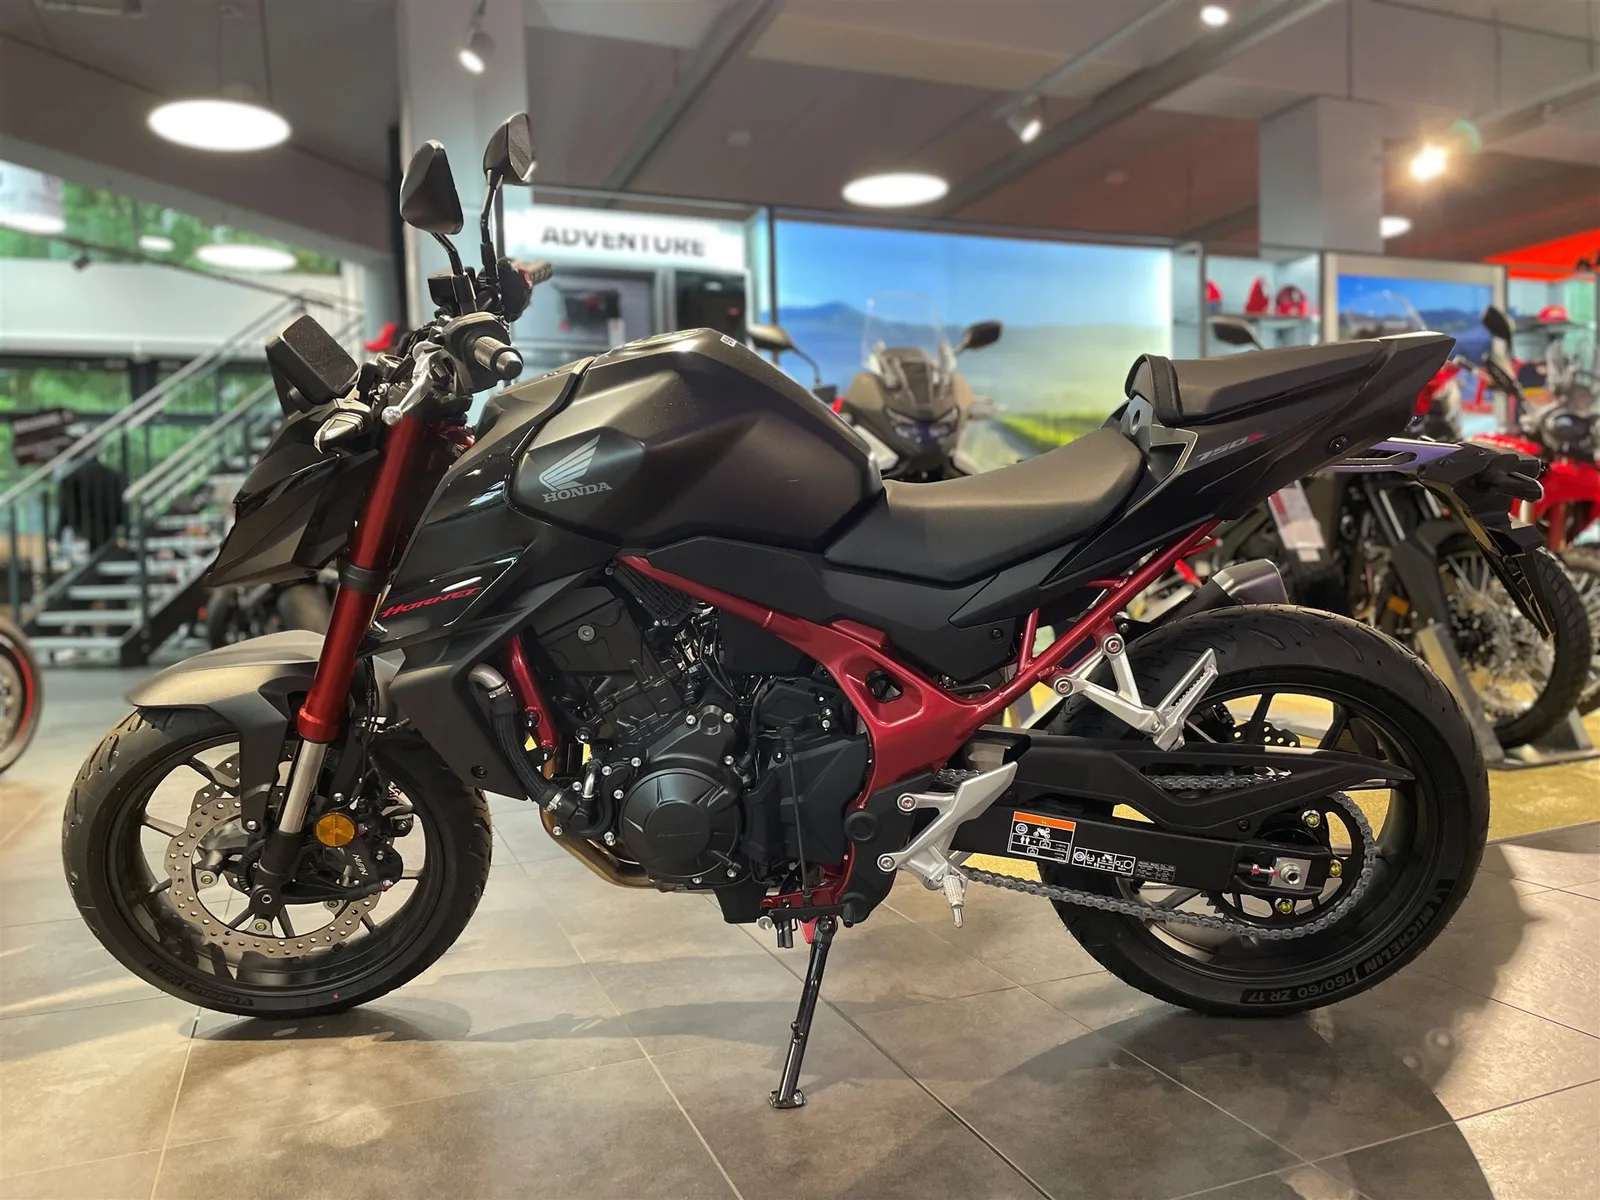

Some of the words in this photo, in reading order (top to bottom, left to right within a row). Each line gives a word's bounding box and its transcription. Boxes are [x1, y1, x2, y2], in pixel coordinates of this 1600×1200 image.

[541, 226, 705, 257] ADVENTURE
[1197, 436, 1249, 461] 750
[542, 482, 612, 503] HONDA
[1364, 905, 1435, 973] MICHELIN
[1248, 991, 1265, 1002] 17
[1270, 990, 1292, 1001] ZR
[1297, 973, 1354, 998] 160/60
